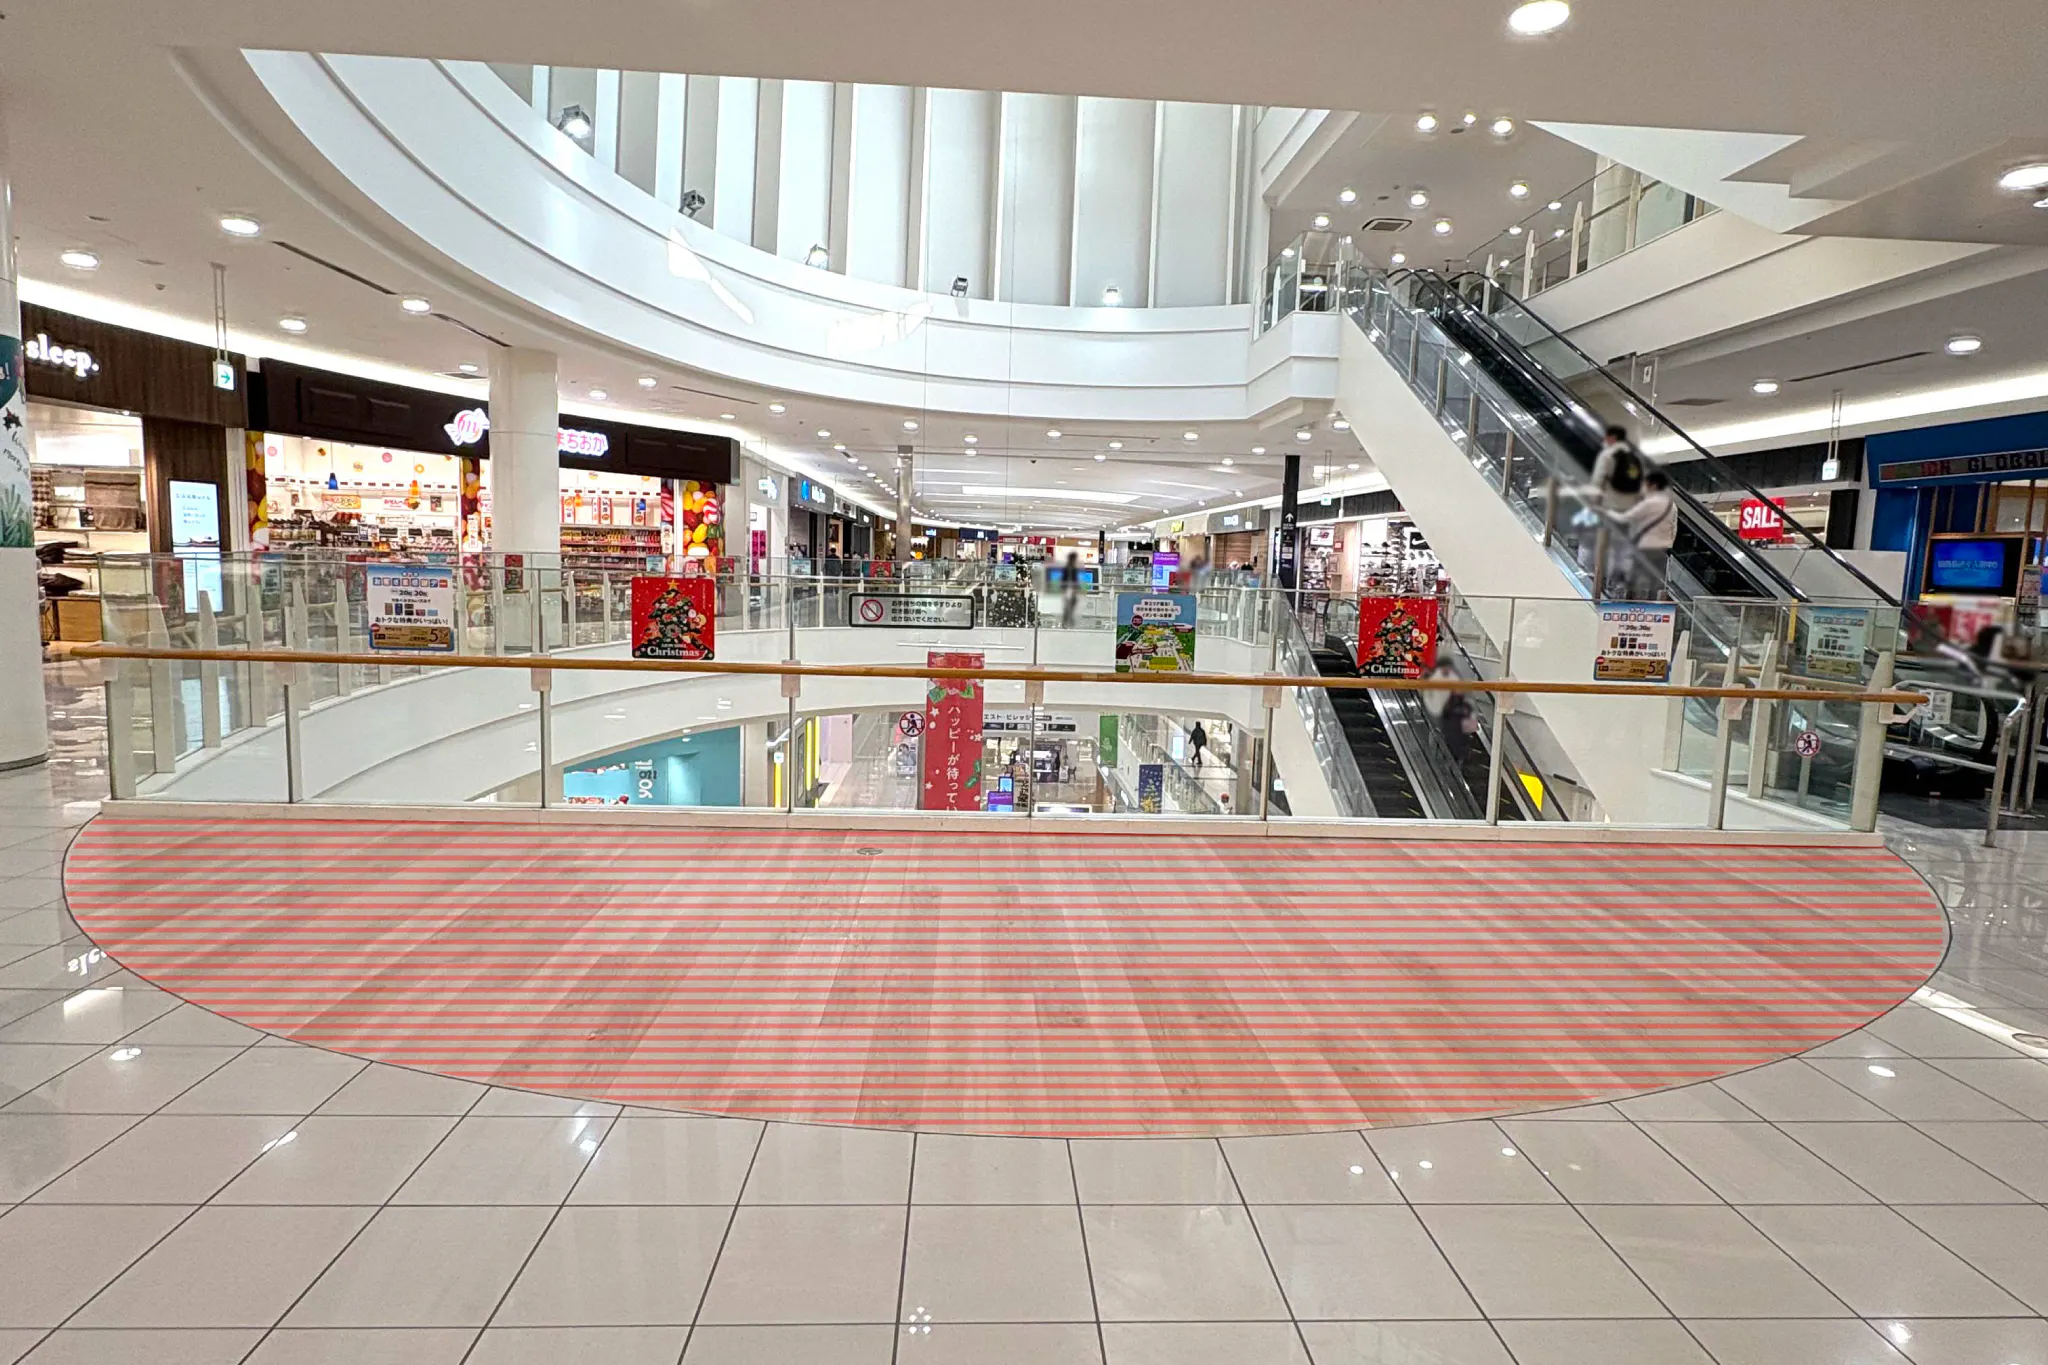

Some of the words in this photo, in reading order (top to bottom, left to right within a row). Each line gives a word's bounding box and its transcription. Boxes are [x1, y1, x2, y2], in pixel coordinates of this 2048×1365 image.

[1742, 506, 1781, 529] SALE
[647, 646, 700, 656] Christmas
[1371, 664, 1419, 674] Christmas
